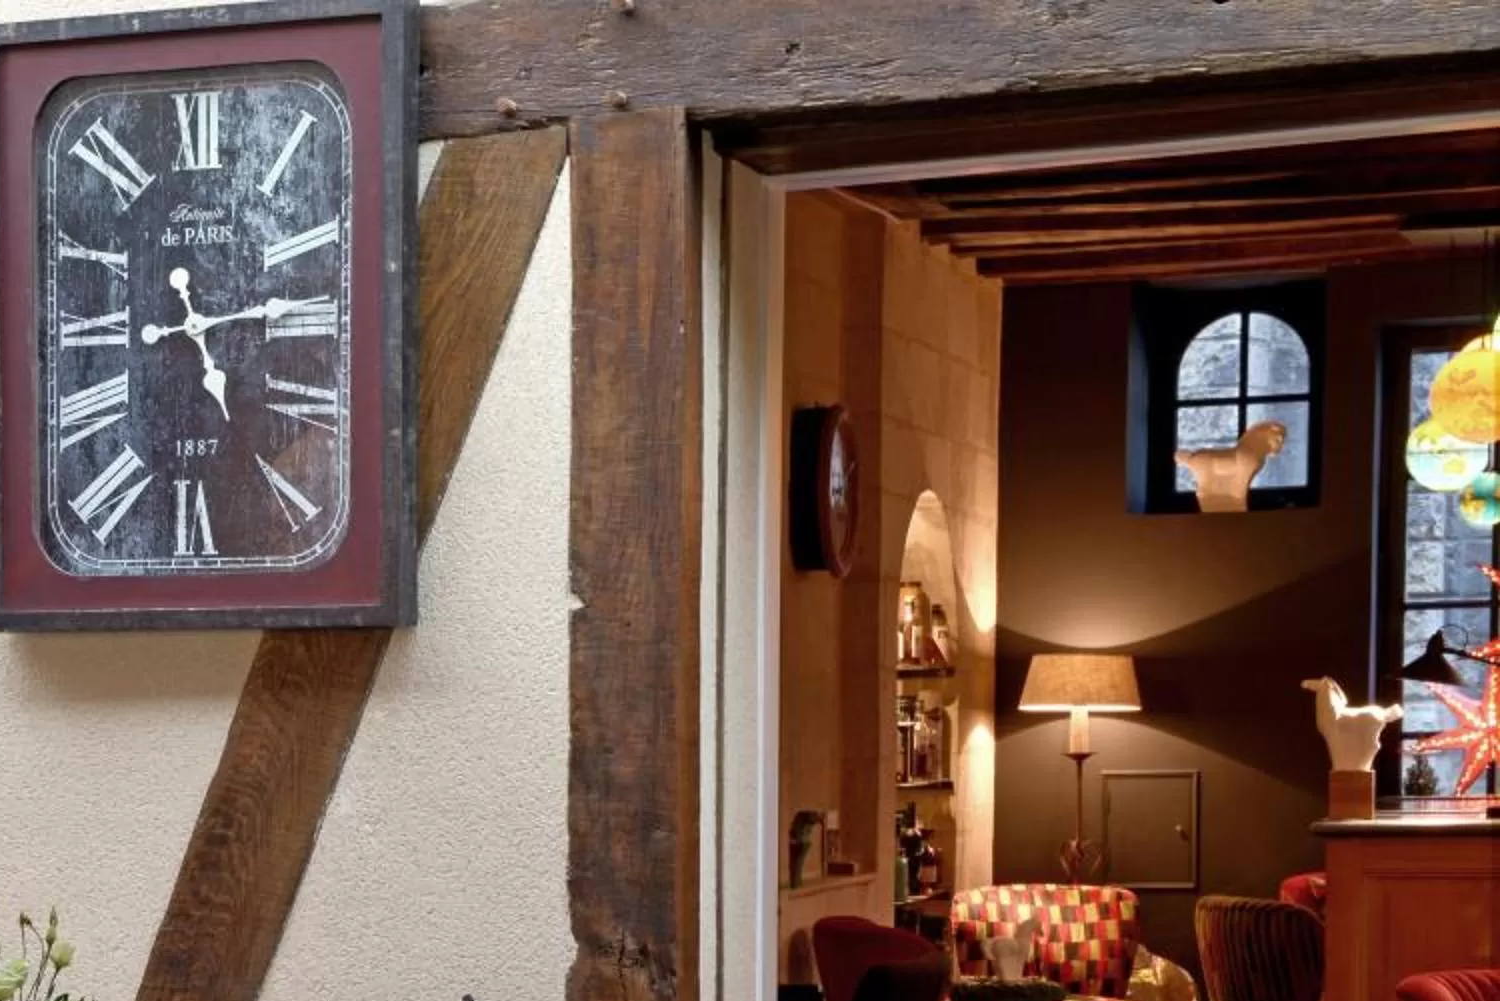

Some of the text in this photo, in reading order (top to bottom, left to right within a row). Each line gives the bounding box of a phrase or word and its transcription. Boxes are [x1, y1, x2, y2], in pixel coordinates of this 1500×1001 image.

[68, 116, 156, 211] XI
[169, 91, 223, 171] XII
[257, 110, 318, 197] I
[58, 229, 129, 280] X
[161, 225, 233, 247] de PARIS
[264, 213, 339, 272] II
[265, 299, 338, 342] III
[60, 368, 129, 453] VIII
[176, 439, 219, 457] 1887
[173, 479, 219, 555] VI
[255, 453, 323, 533] V
